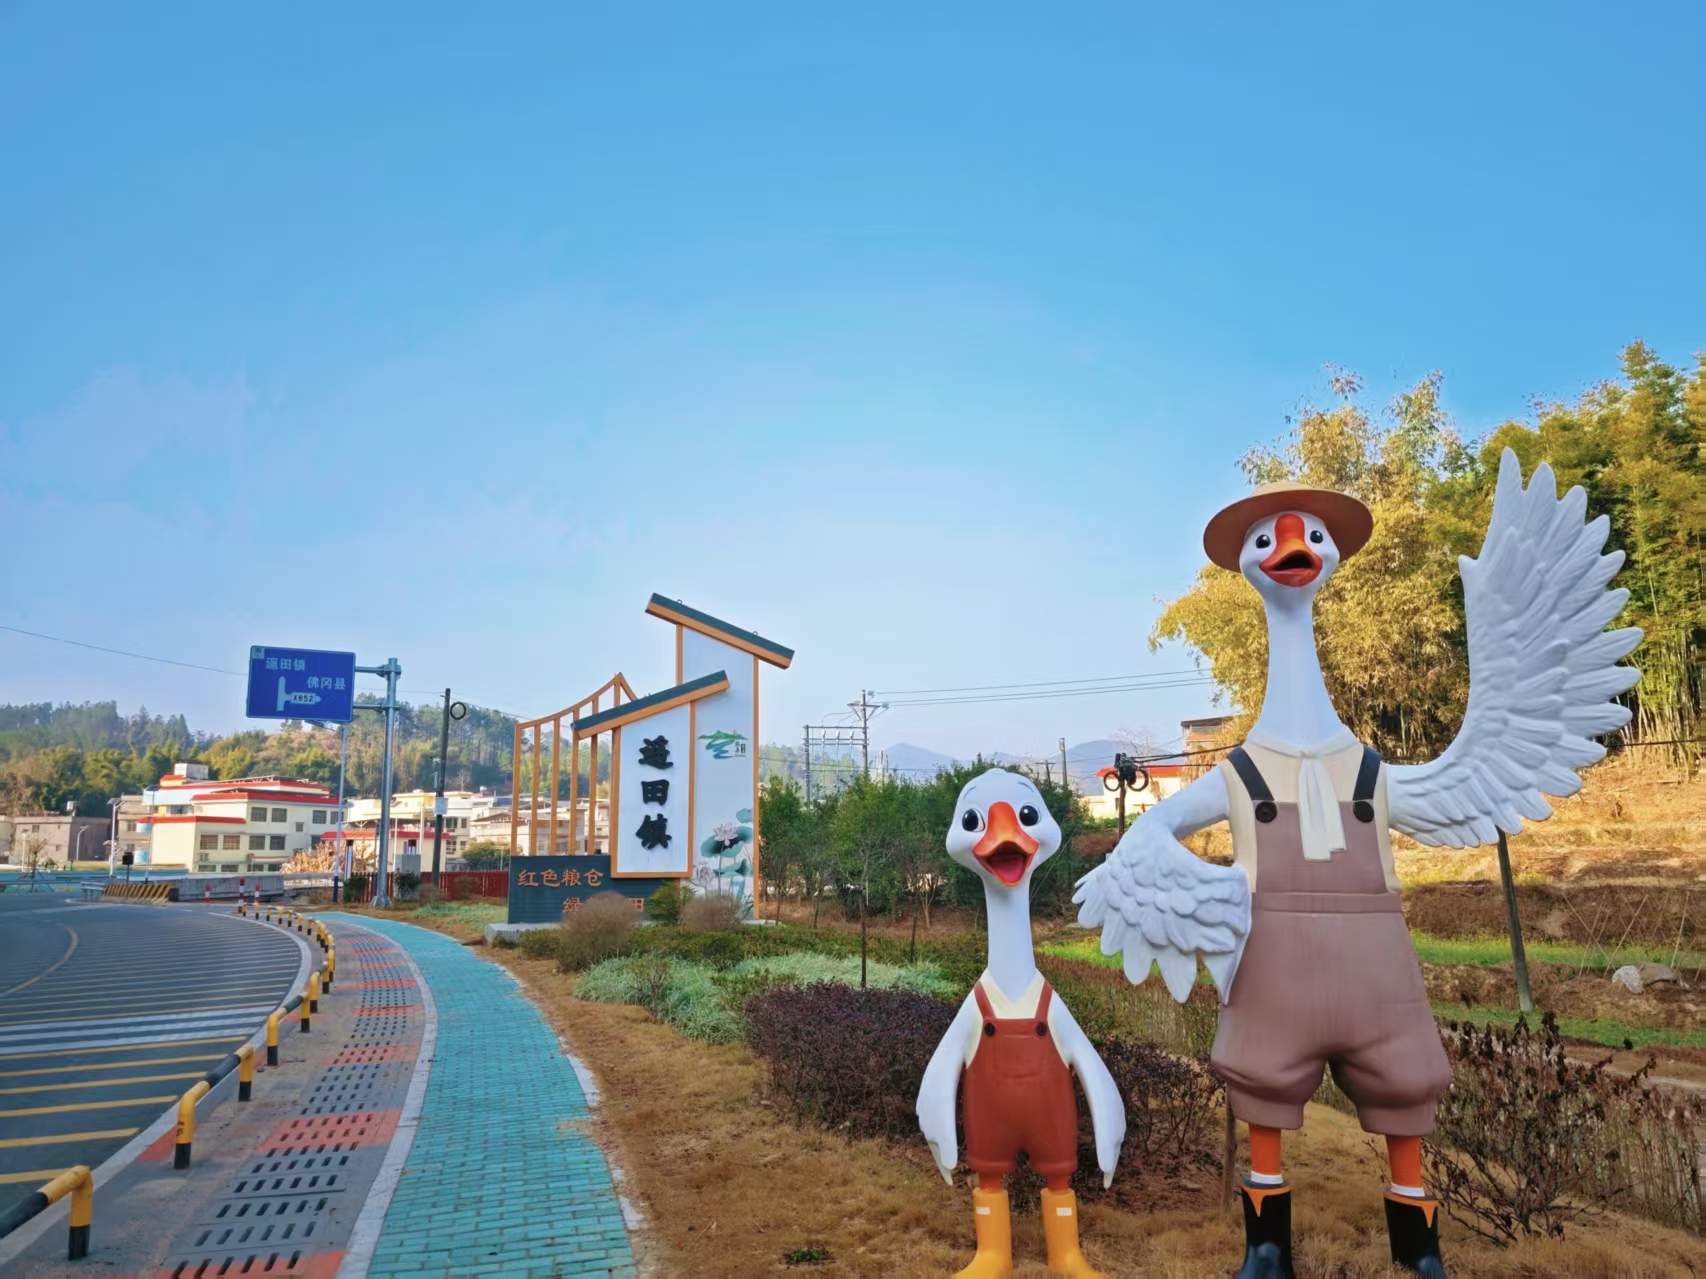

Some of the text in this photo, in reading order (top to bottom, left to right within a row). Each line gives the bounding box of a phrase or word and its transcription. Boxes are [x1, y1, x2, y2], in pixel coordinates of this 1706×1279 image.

[306, 676, 346, 690] 佛冈县
[293, 694, 314, 703] X852
[518, 868, 604, 888] 红色粮仓
